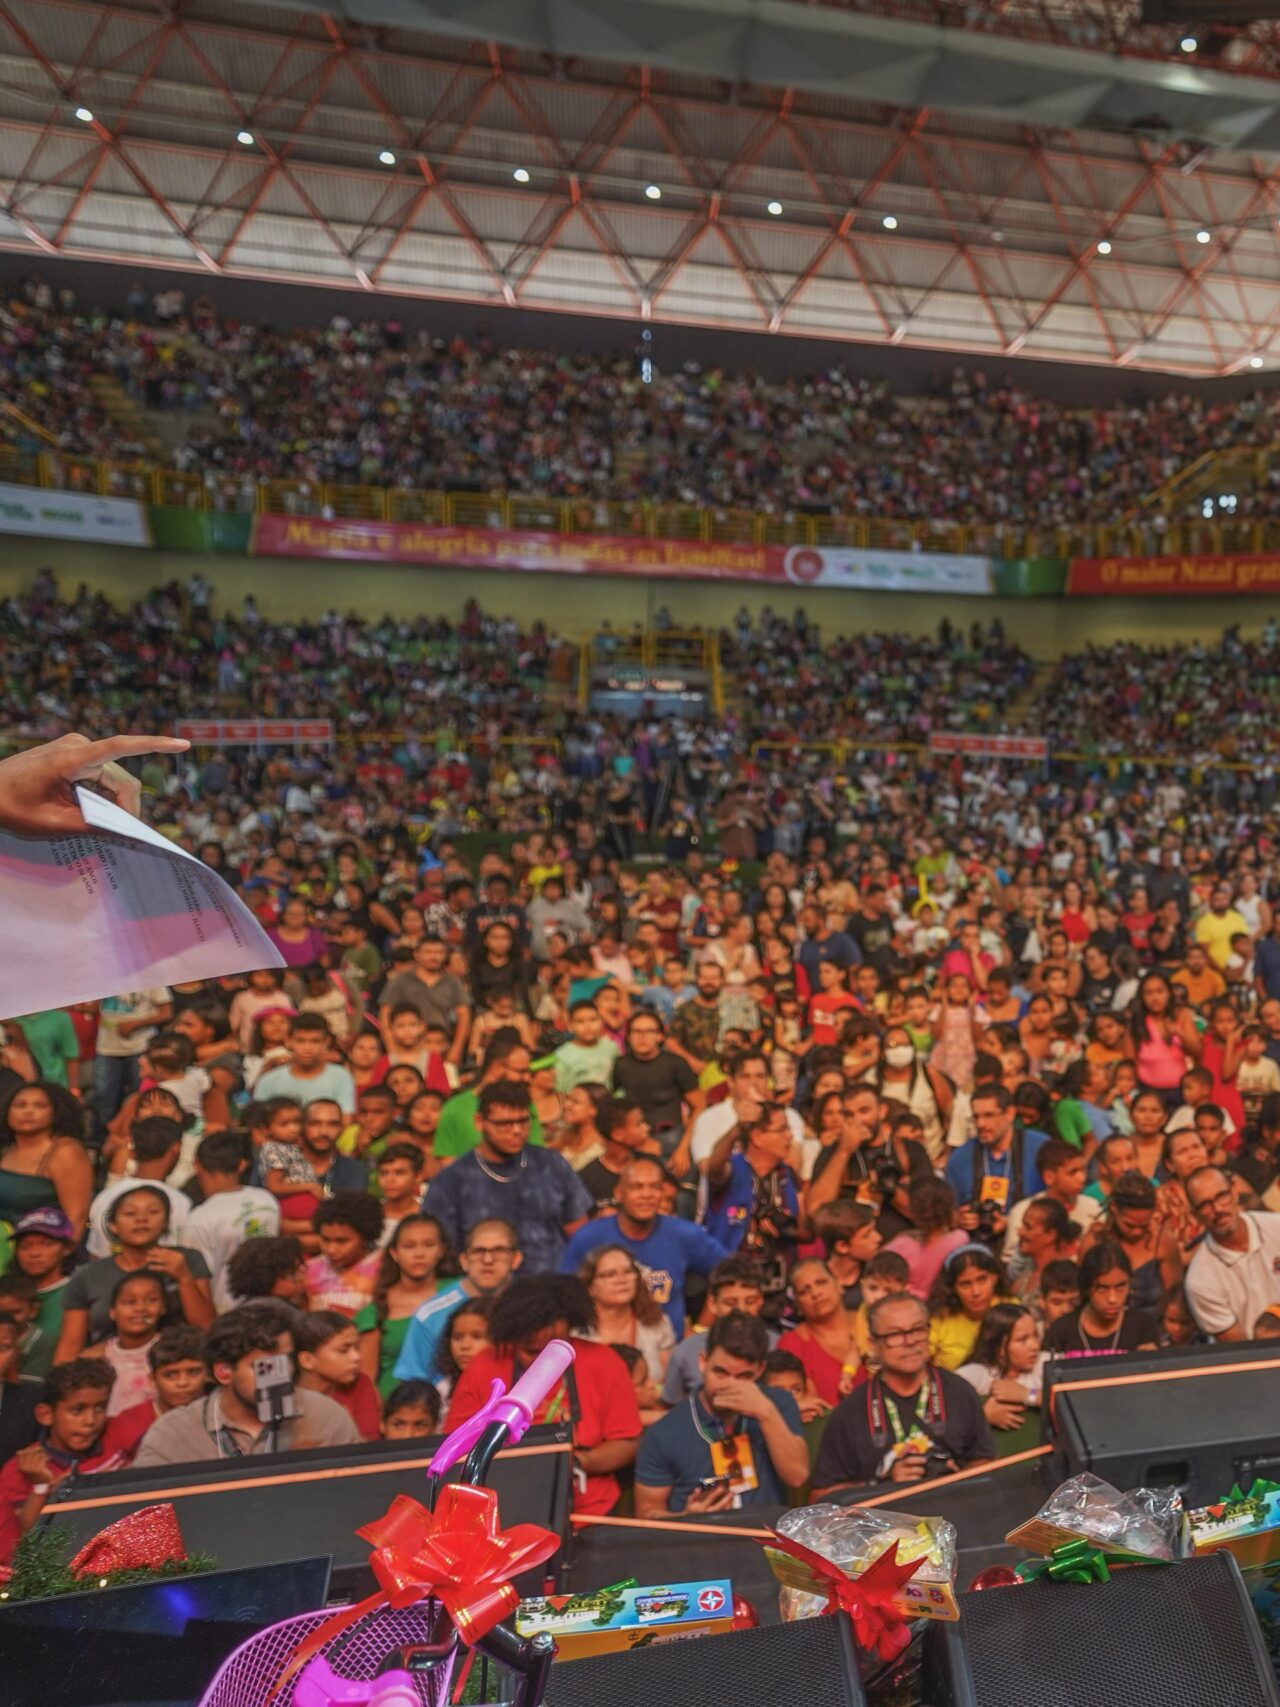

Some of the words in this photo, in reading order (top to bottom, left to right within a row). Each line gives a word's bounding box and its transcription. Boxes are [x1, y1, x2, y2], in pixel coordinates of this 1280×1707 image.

[376, 534, 391, 549] e
[403, 532, 489, 561] alegria
[1101, 562, 1118, 583] O
[1120, 560, 1176, 583] maior
[1180, 560, 1232, 582] Natal
